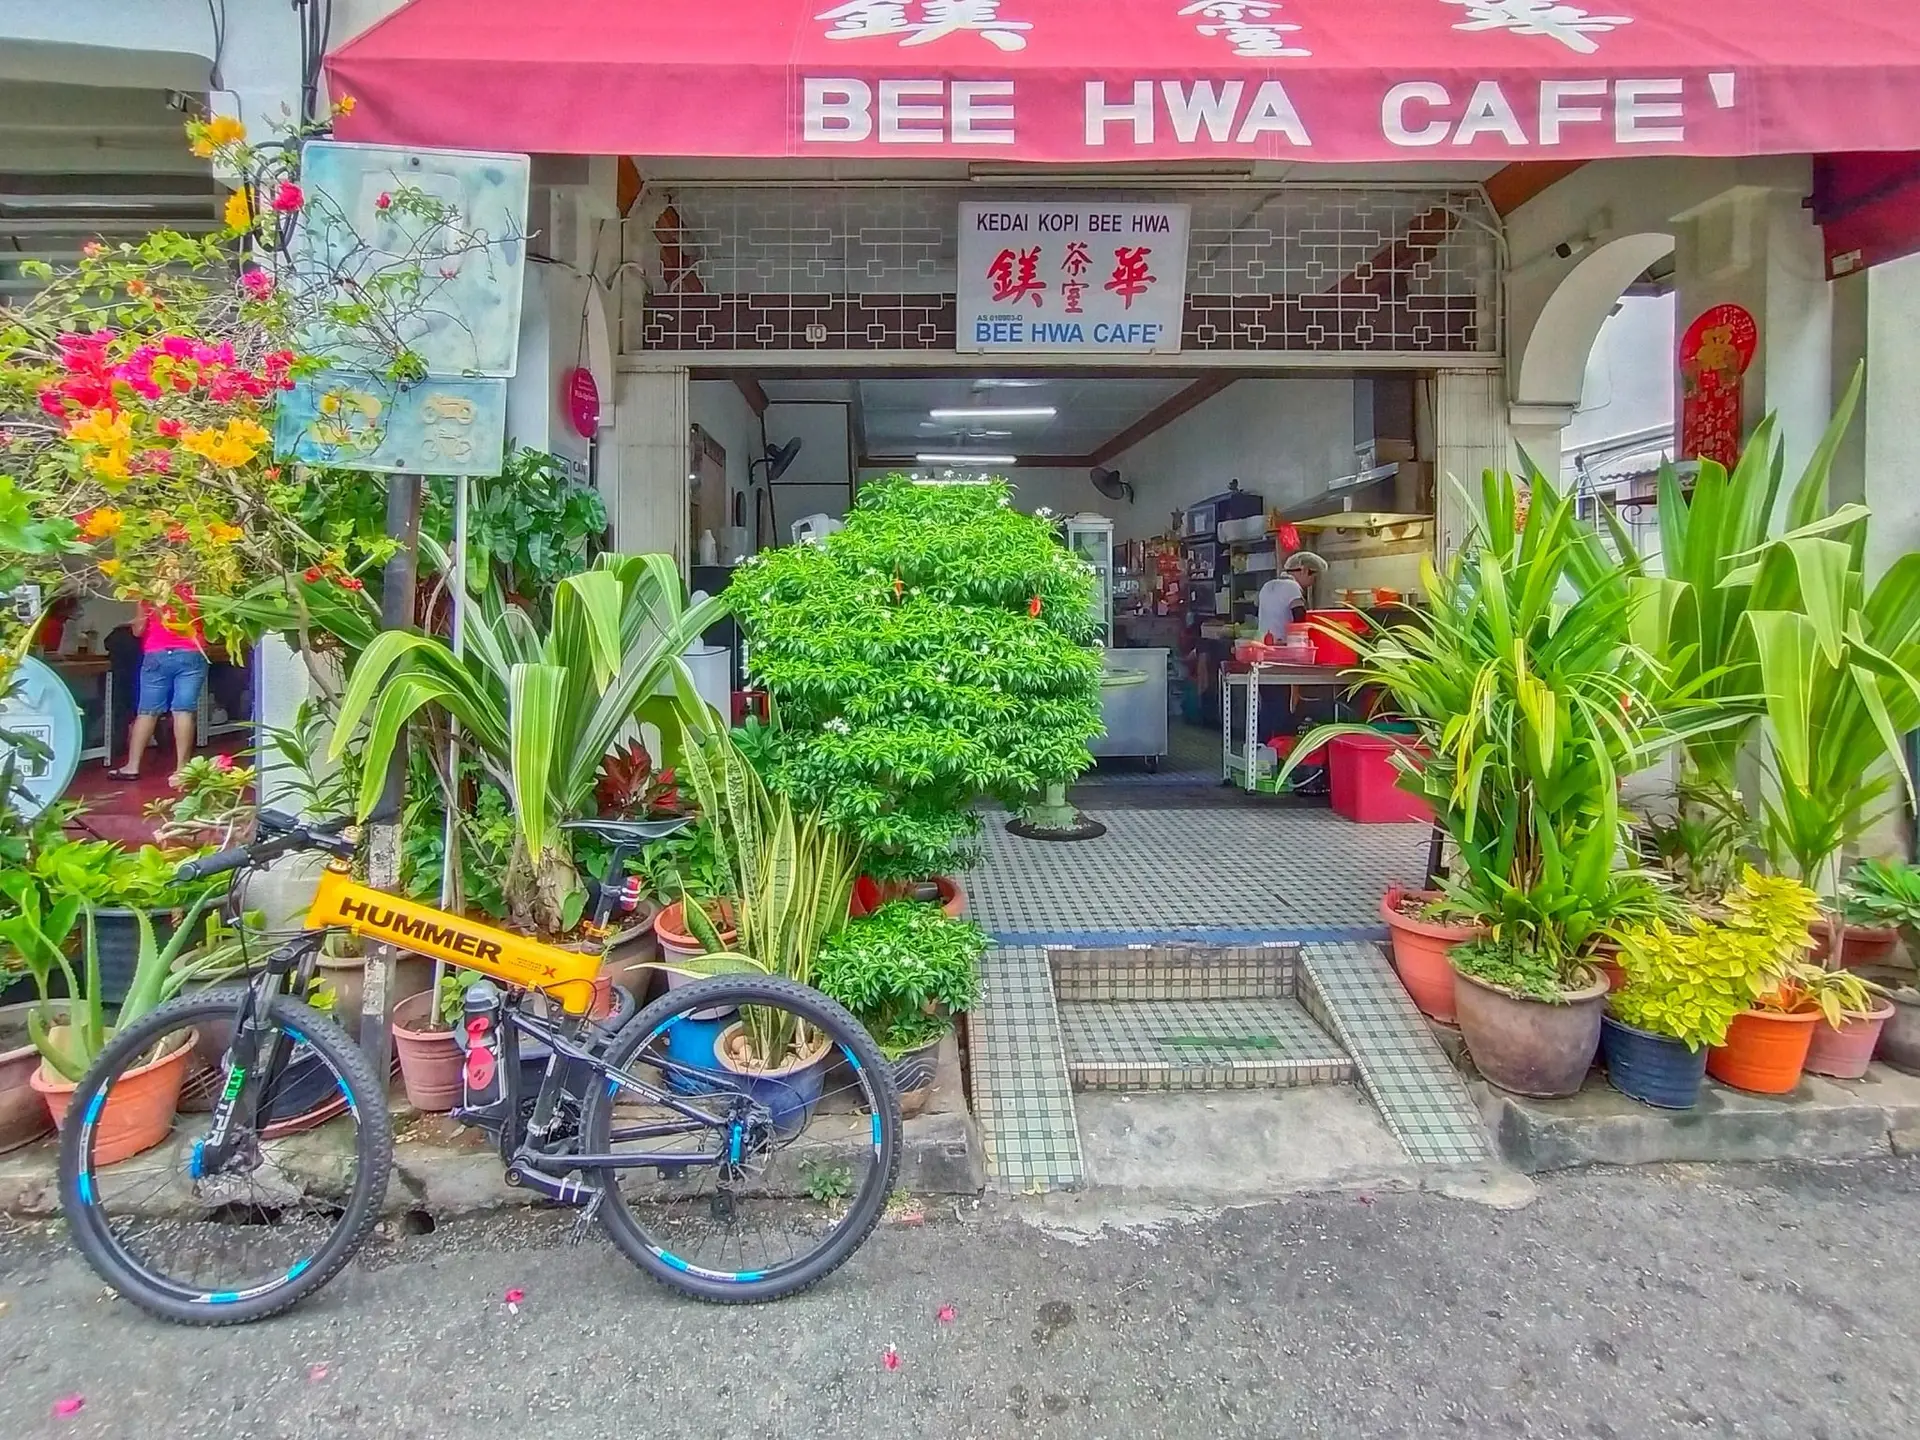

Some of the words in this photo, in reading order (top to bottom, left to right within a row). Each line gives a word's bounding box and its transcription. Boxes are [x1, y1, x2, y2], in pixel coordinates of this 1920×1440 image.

[803, 77, 1016, 145] BEE
[1085, 80, 1312, 146] HWA
[976, 213, 1029, 232] KEDAI
[1038, 214, 1079, 232] KOPI
[1088, 214, 1123, 232] BEE
[1132, 215, 1170, 233] HWA
[1103, 246, 1158, 310] 華
[810, 326, 823, 340] 10
[976, 323, 1024, 343] BEE
[1031, 324, 1084, 343] HWA
[338, 896, 503, 965] HUMMER
